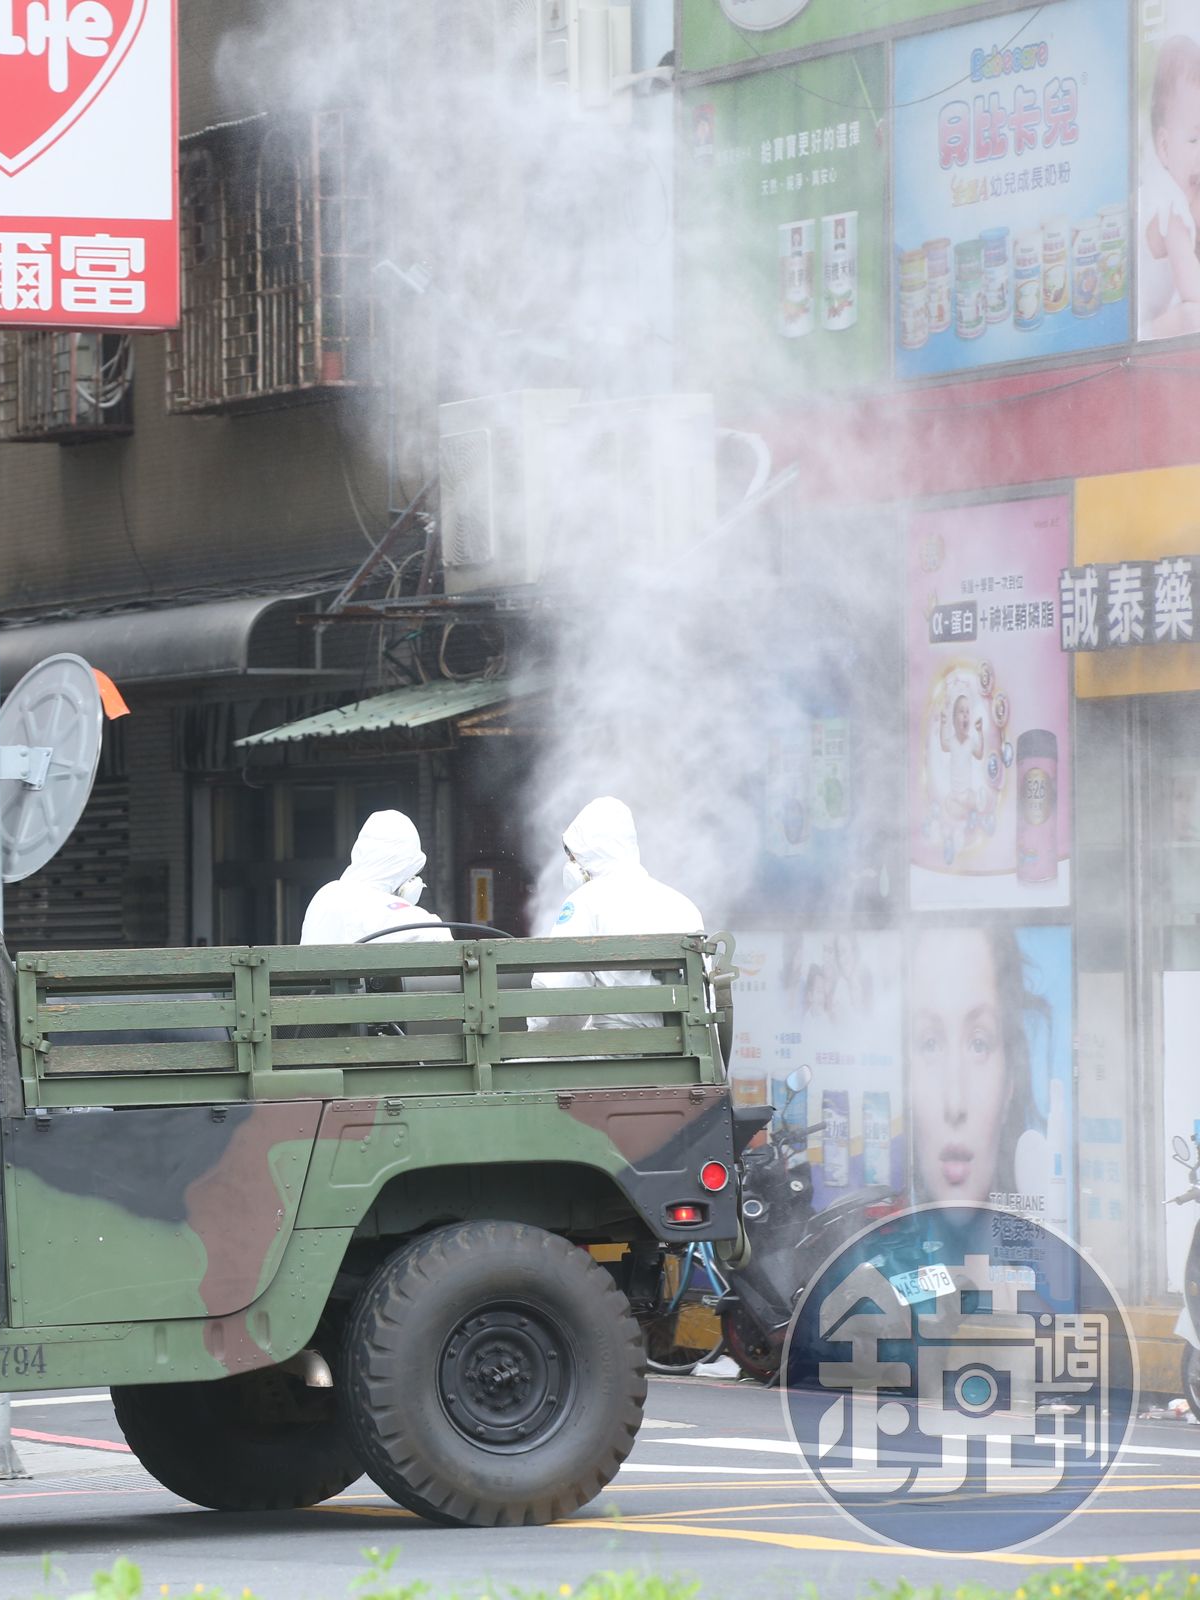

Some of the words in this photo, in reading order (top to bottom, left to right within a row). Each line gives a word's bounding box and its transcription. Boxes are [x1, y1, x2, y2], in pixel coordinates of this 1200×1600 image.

[938, 76, 1079, 170] 貝比卡兒
[1060, 557, 1194, 651] 誠泰藥
